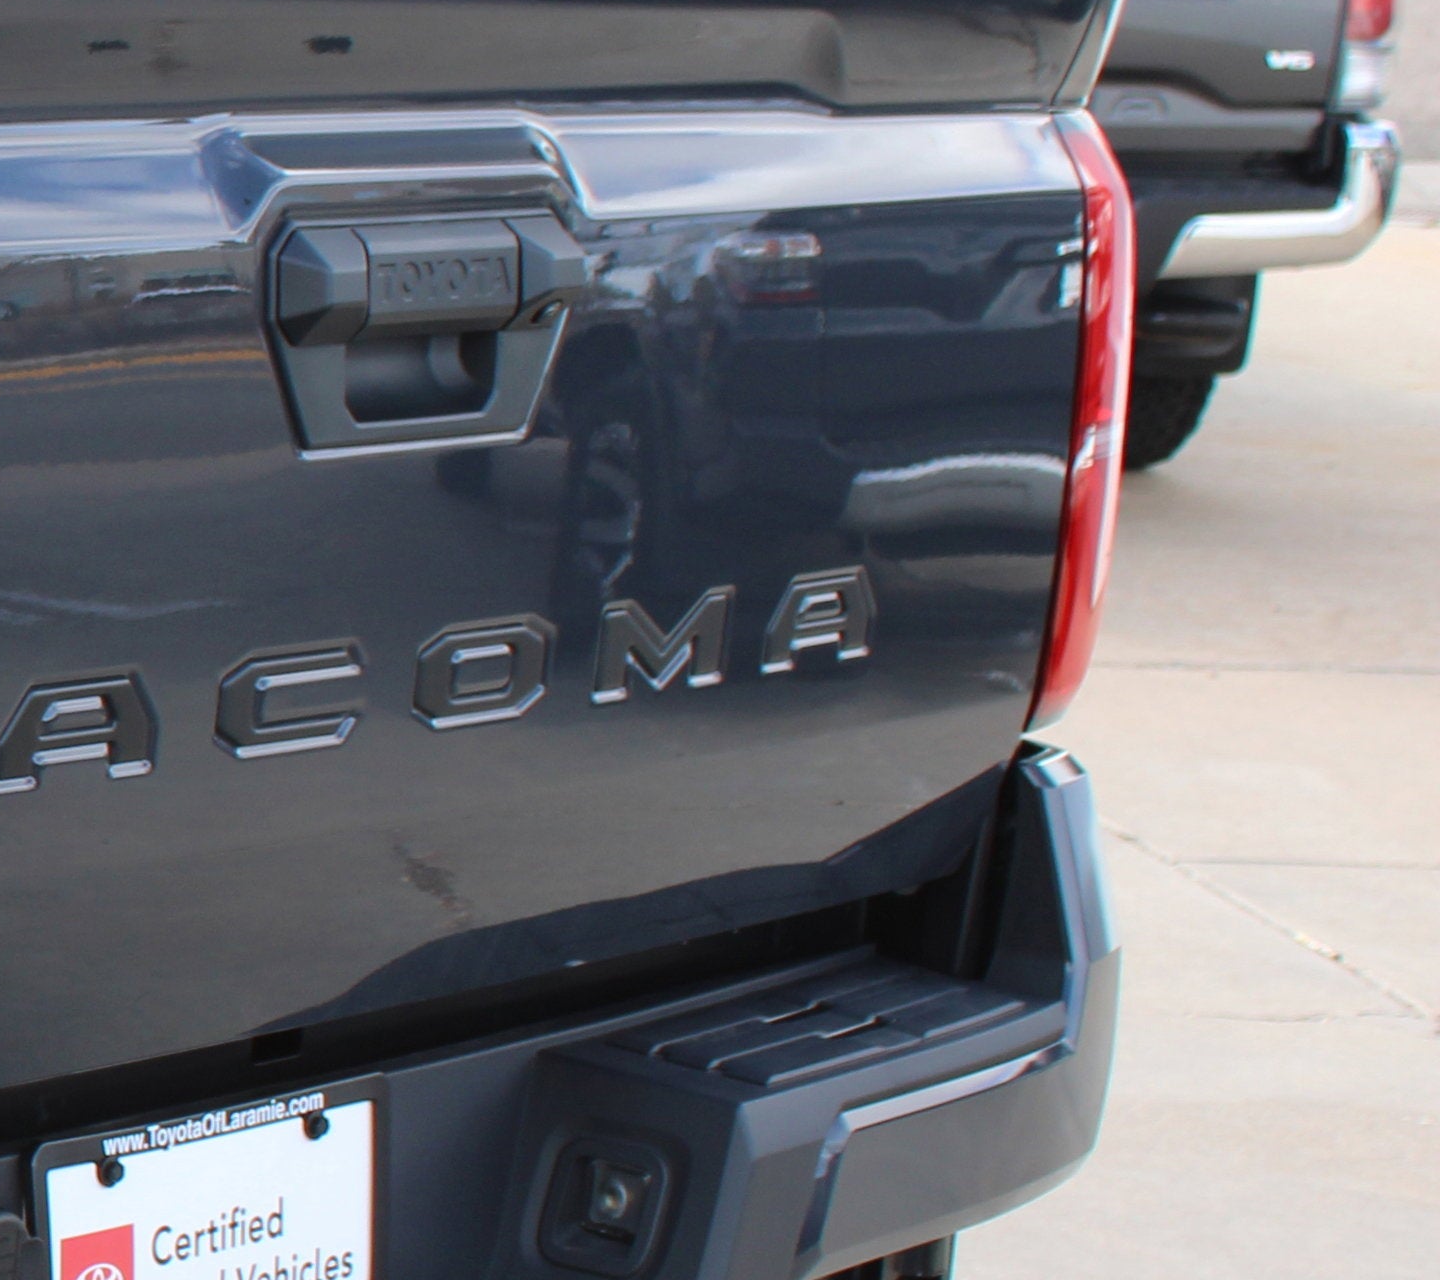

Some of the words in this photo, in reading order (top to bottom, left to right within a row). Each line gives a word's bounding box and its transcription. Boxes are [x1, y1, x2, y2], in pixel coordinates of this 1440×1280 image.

[378, 256, 513, 302] TOYOTA
[102, 1092, 325, 1156] www.ToyotaOfLaramie.com
[151, 1195, 284, 1266] Certified
